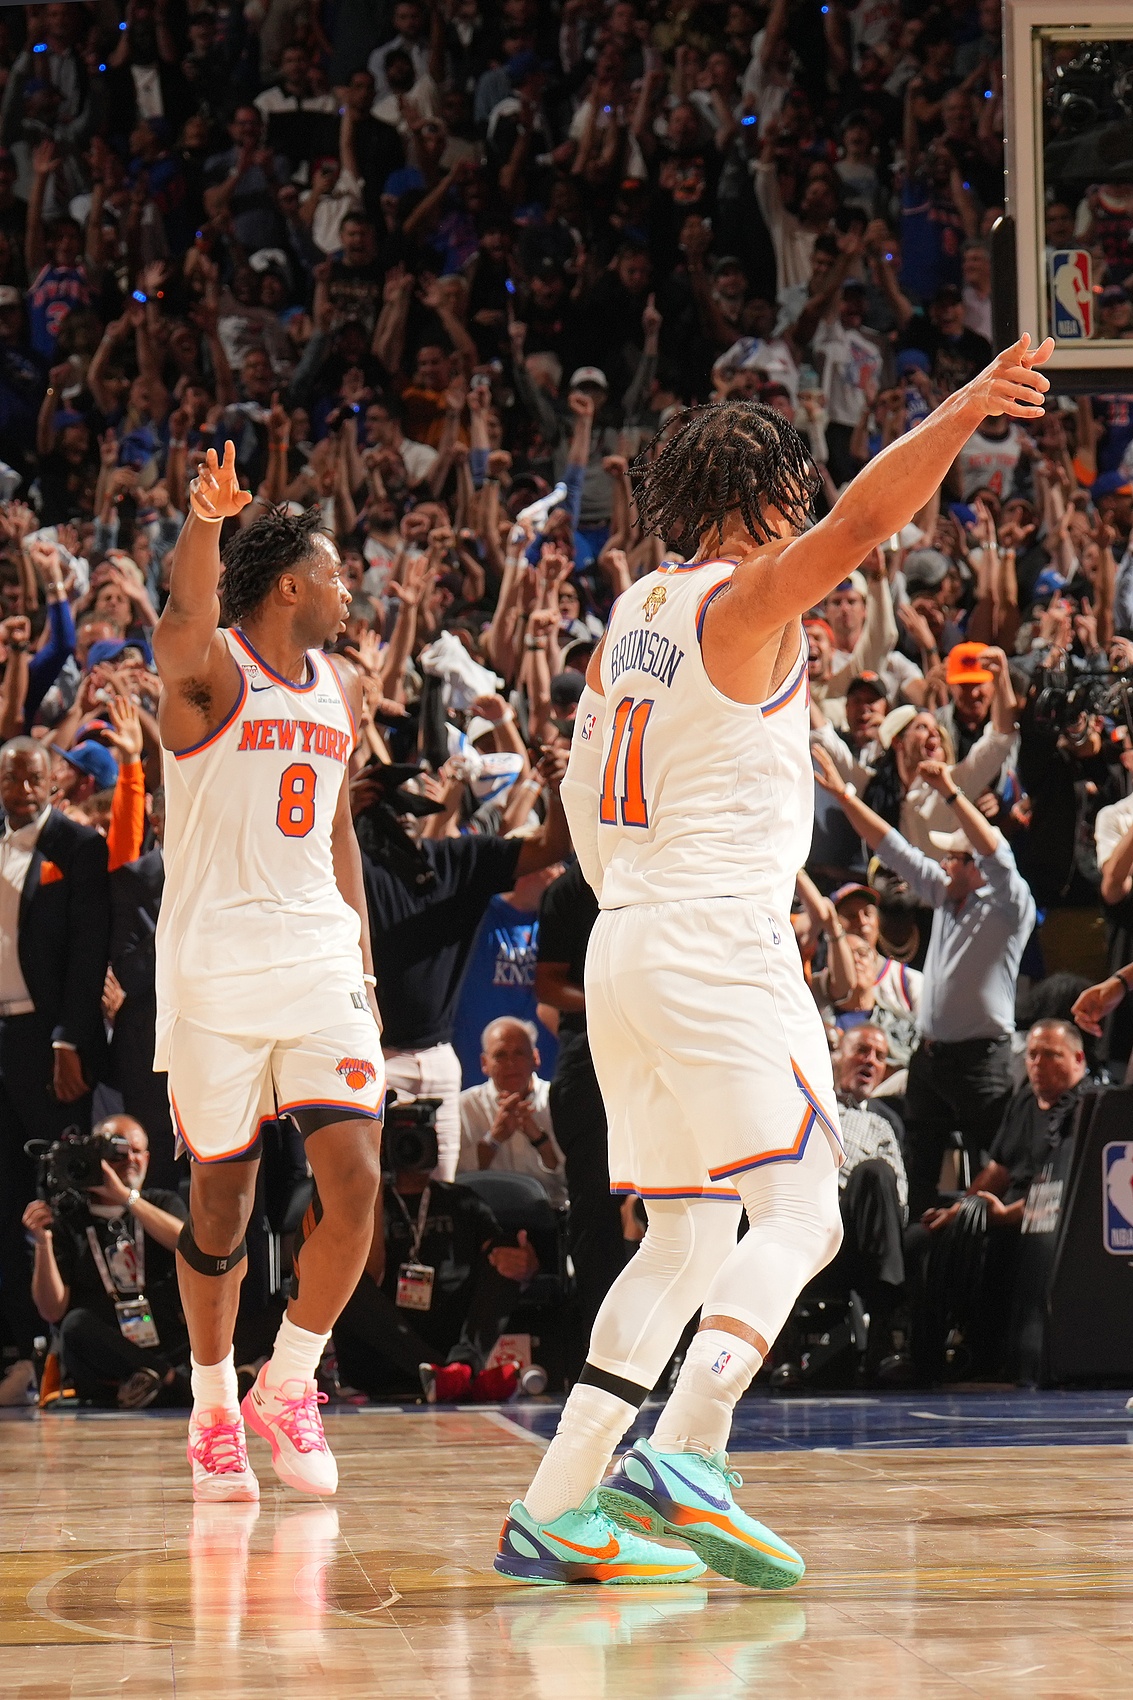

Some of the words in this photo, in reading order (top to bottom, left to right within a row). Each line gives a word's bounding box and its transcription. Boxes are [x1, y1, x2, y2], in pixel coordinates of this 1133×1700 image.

[611, 629, 685, 689] BRUNSON
[236, 718, 298, 752] NEW
[299, 720, 350, 767] YORK
[600, 697, 655, 829] 11
[276, 763, 318, 838] 8
[335, 1057, 377, 1081] KNICKS
